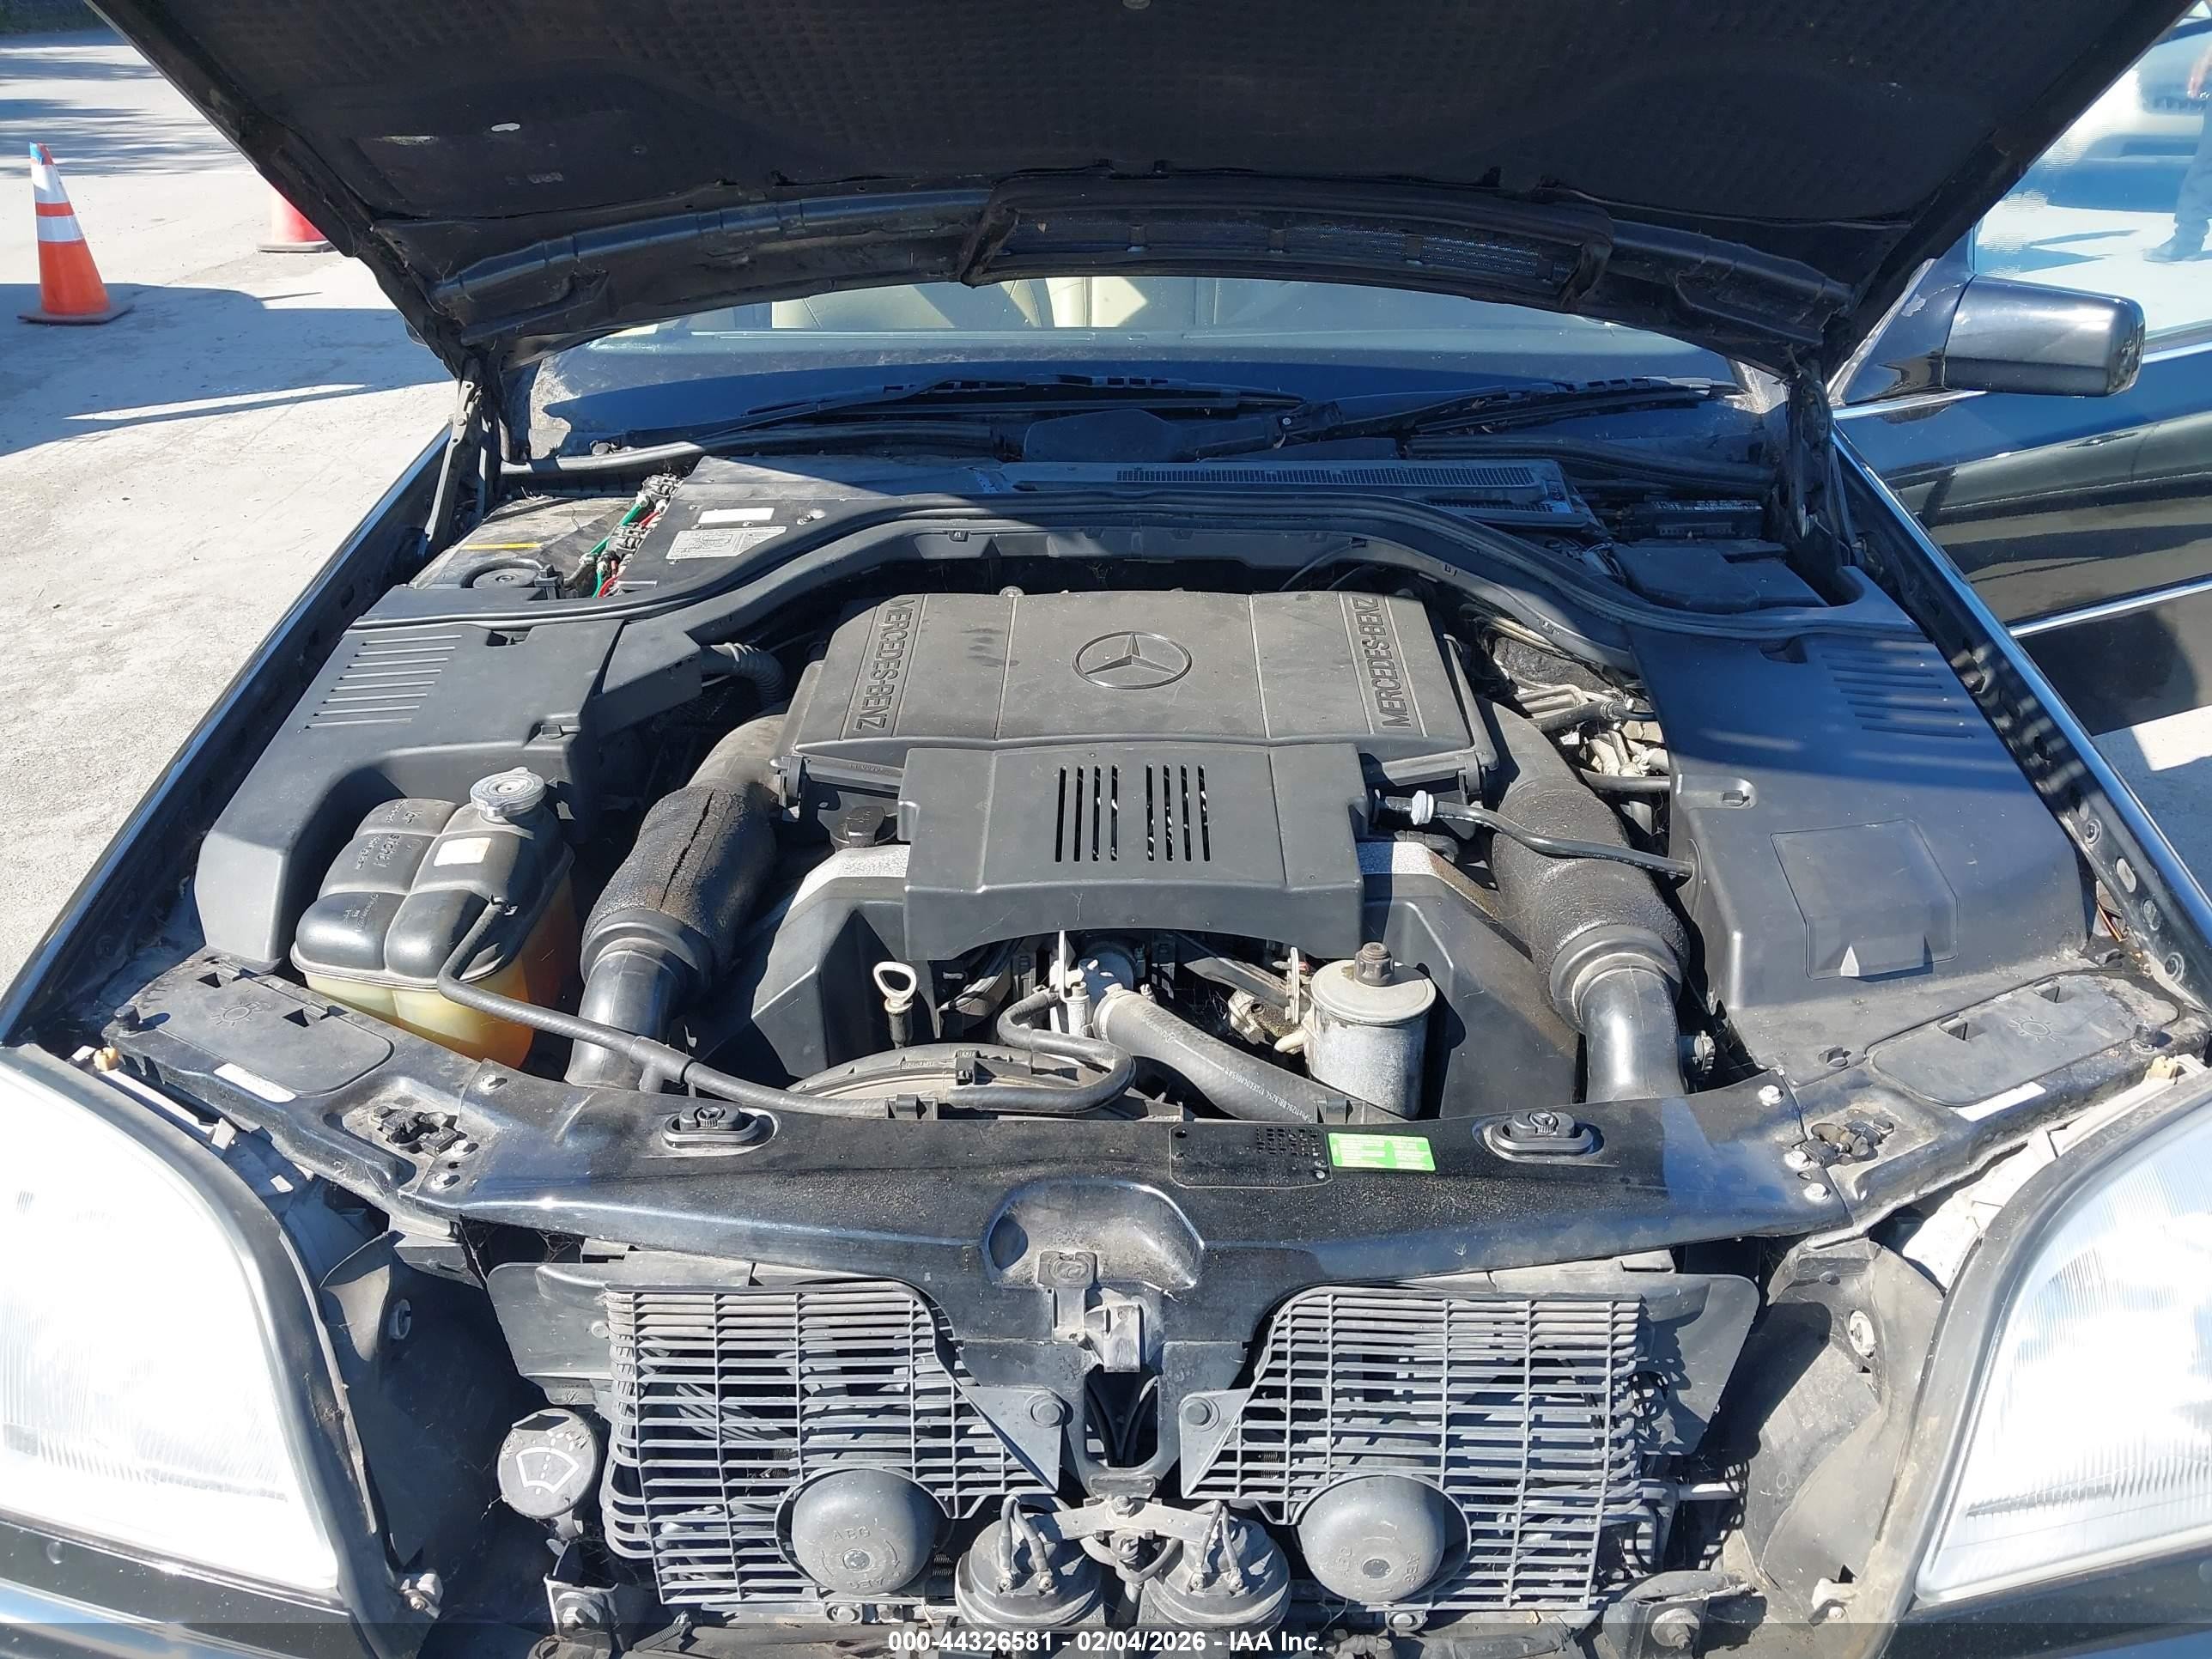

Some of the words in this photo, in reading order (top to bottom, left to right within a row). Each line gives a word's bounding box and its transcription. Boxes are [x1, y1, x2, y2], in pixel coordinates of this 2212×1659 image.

[854, 599, 916, 732] MERCEDES-BENZ
[1352, 596, 1412, 728] MERCEDES-BENZ
[832, 1524, 872, 1543] AEG
